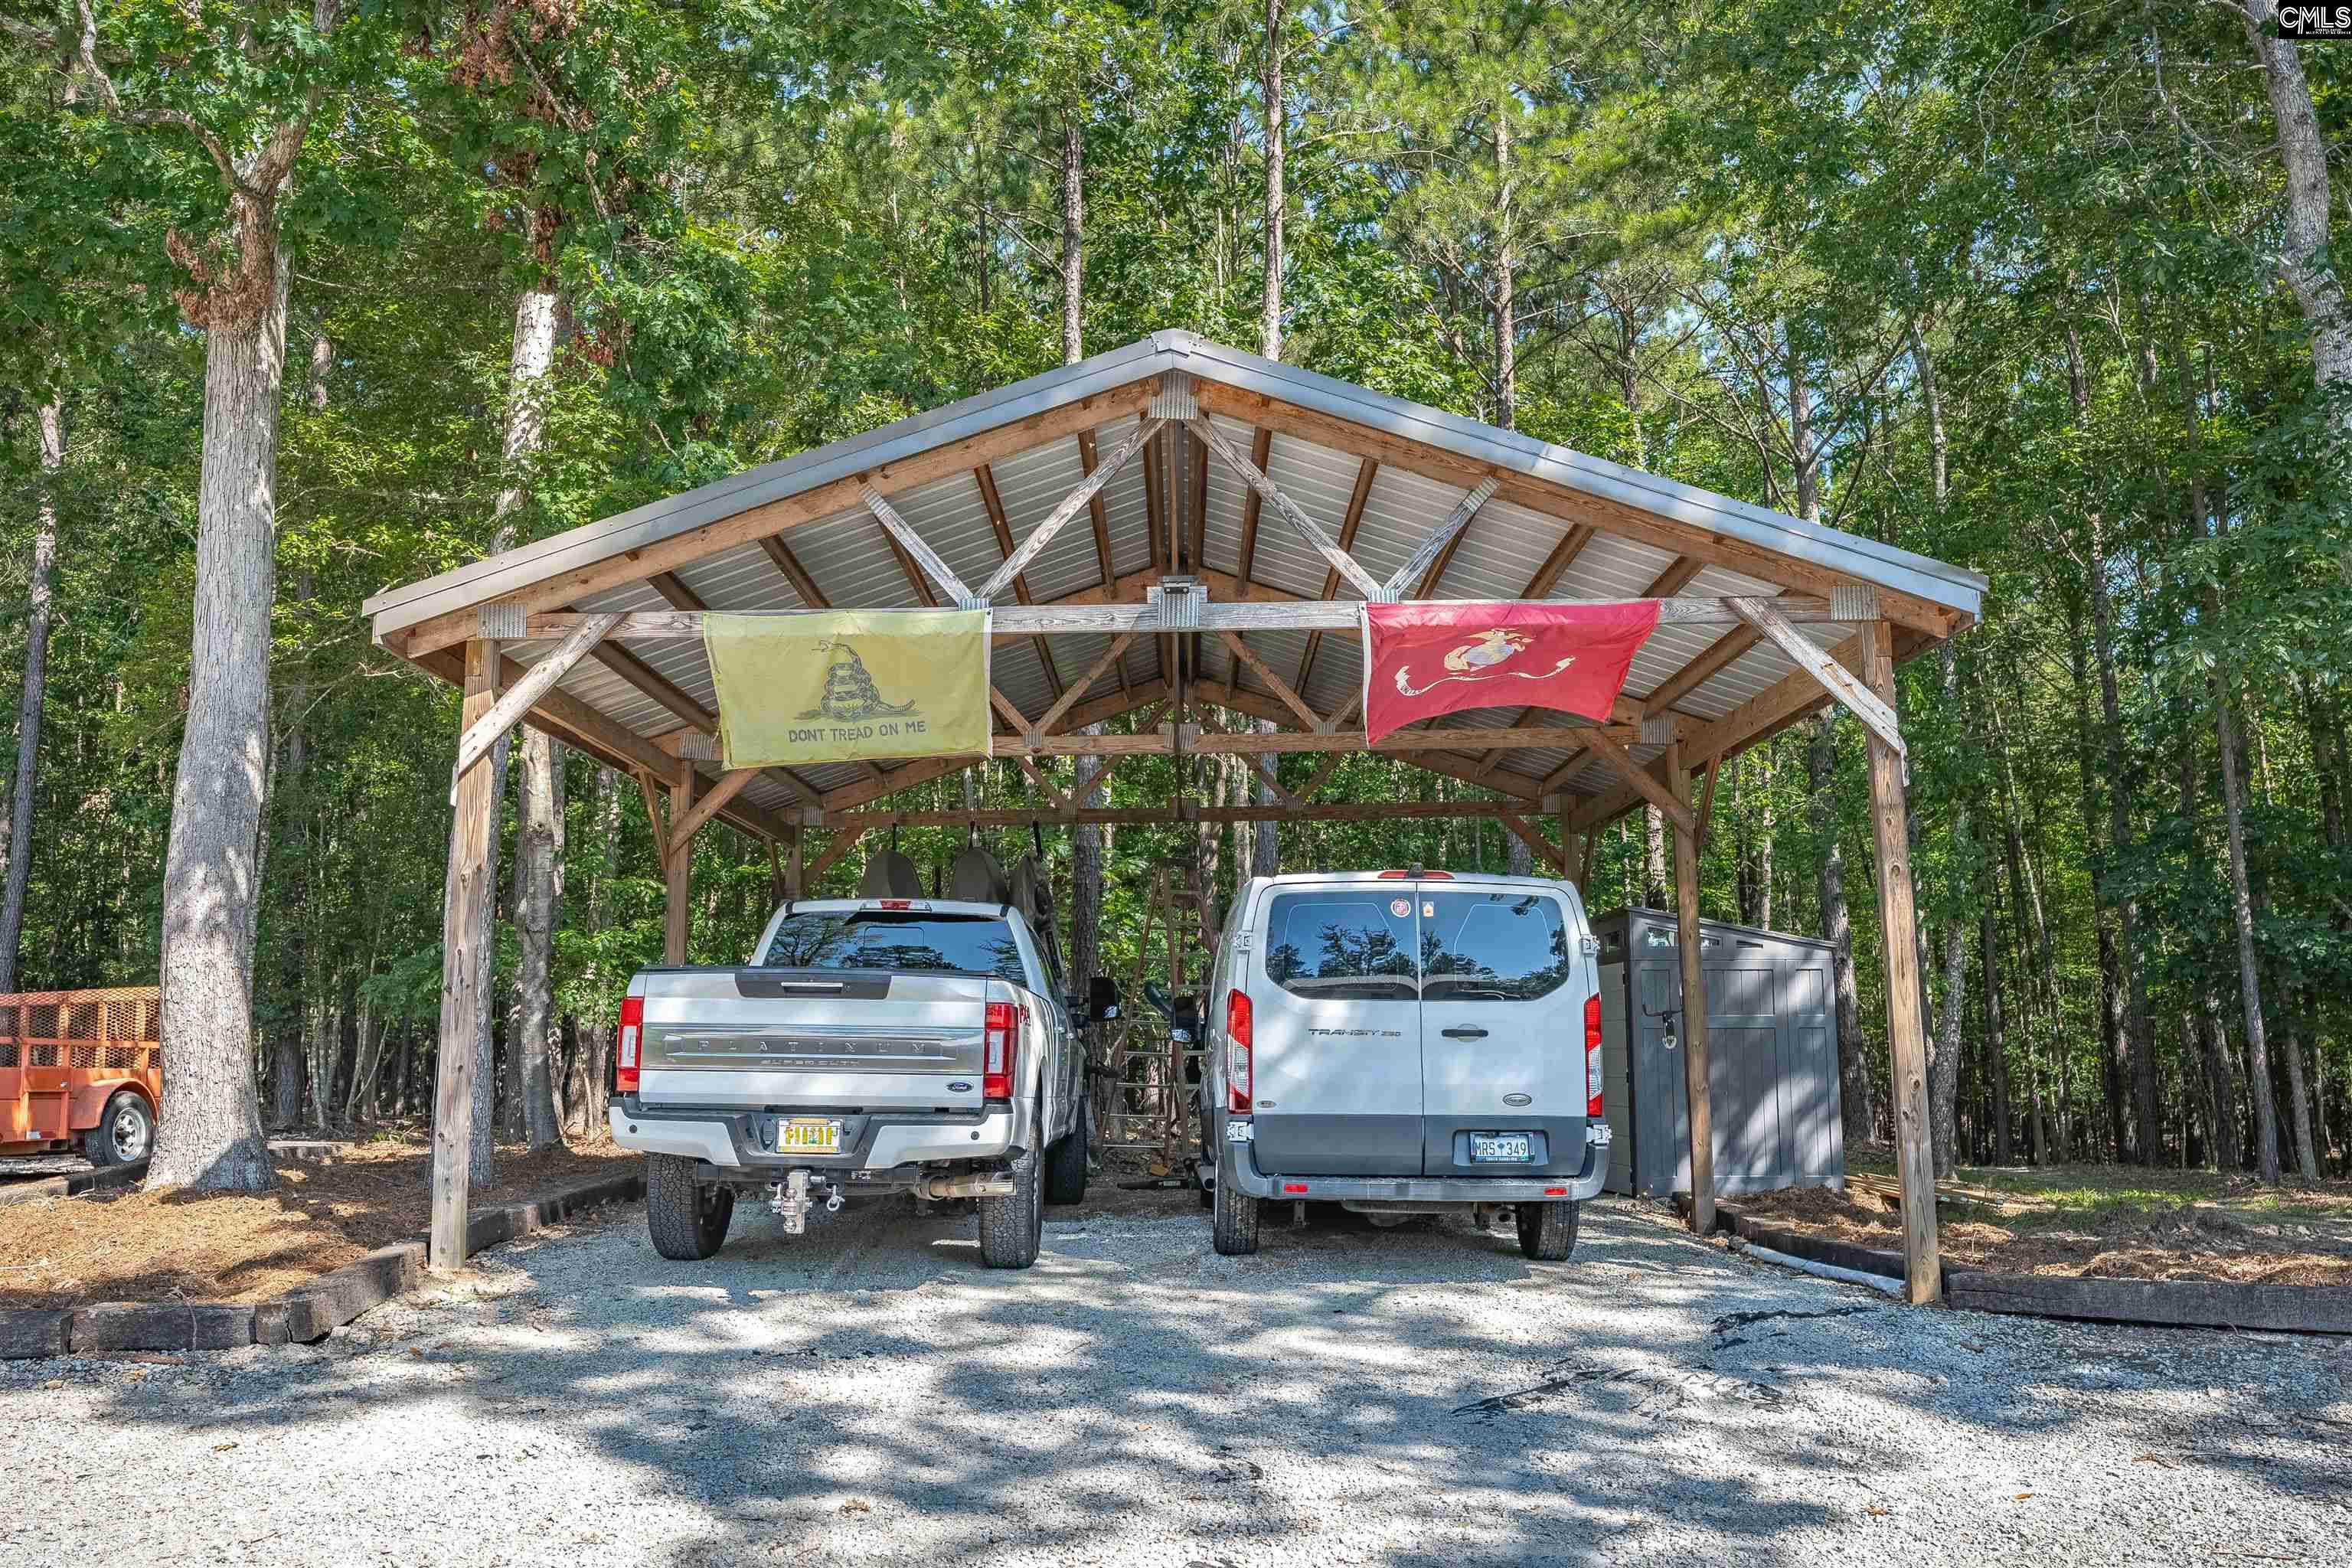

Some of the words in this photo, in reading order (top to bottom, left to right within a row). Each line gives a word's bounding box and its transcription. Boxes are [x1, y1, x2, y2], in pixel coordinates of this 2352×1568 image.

[789, 728, 825, 742] DONT
[830, 726, 873, 741] TREAD
[879, 723, 899, 736] ON
[906, 720, 926, 733] ME
[697, 1040, 926, 1053] PLATINUM
[1475, 1142, 1495, 1155] MRS
[1506, 1142, 1527, 1155] 349
